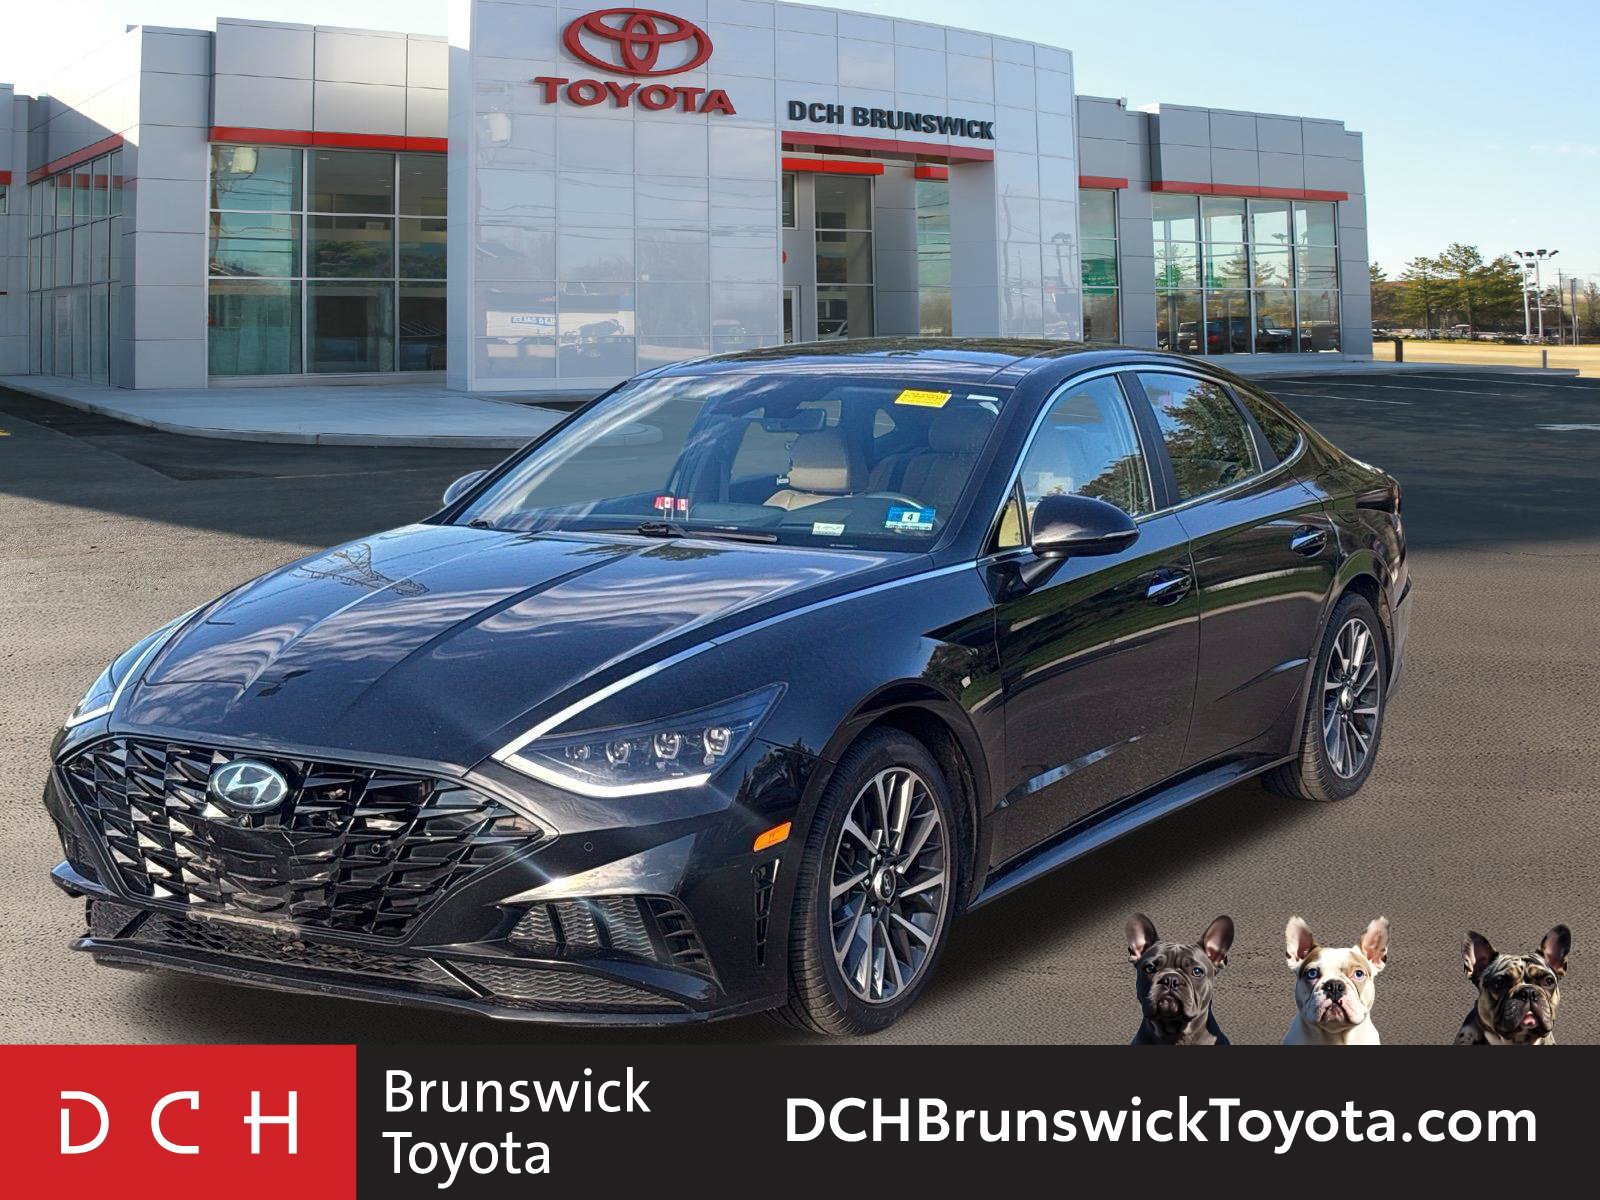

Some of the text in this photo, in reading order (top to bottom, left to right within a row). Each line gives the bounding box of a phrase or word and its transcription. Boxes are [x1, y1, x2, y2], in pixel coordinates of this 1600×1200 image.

[534, 76, 736, 115] TOYOTA
[788, 100, 994, 140] DCH BRUNSWICK
